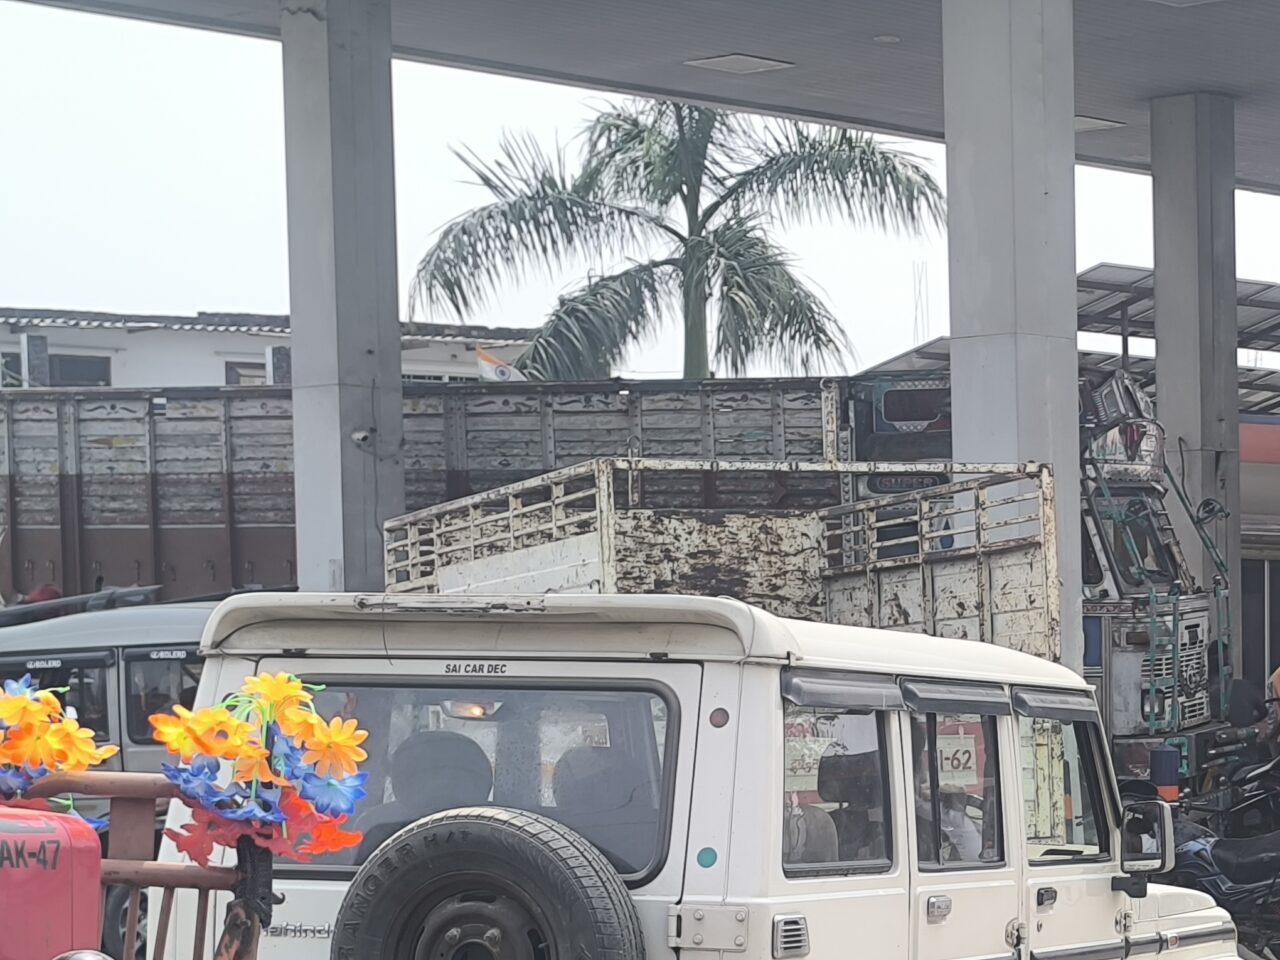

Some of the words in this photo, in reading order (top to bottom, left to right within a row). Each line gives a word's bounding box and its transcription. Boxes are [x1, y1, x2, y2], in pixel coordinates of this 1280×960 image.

[880, 476, 935, 489] SUPER
[445, 663, 461, 674] SAI
[464, 663, 485, 674] CAR
[487, 663, 507, 674] DEC
[0, 839, 61, 871] AK-47
